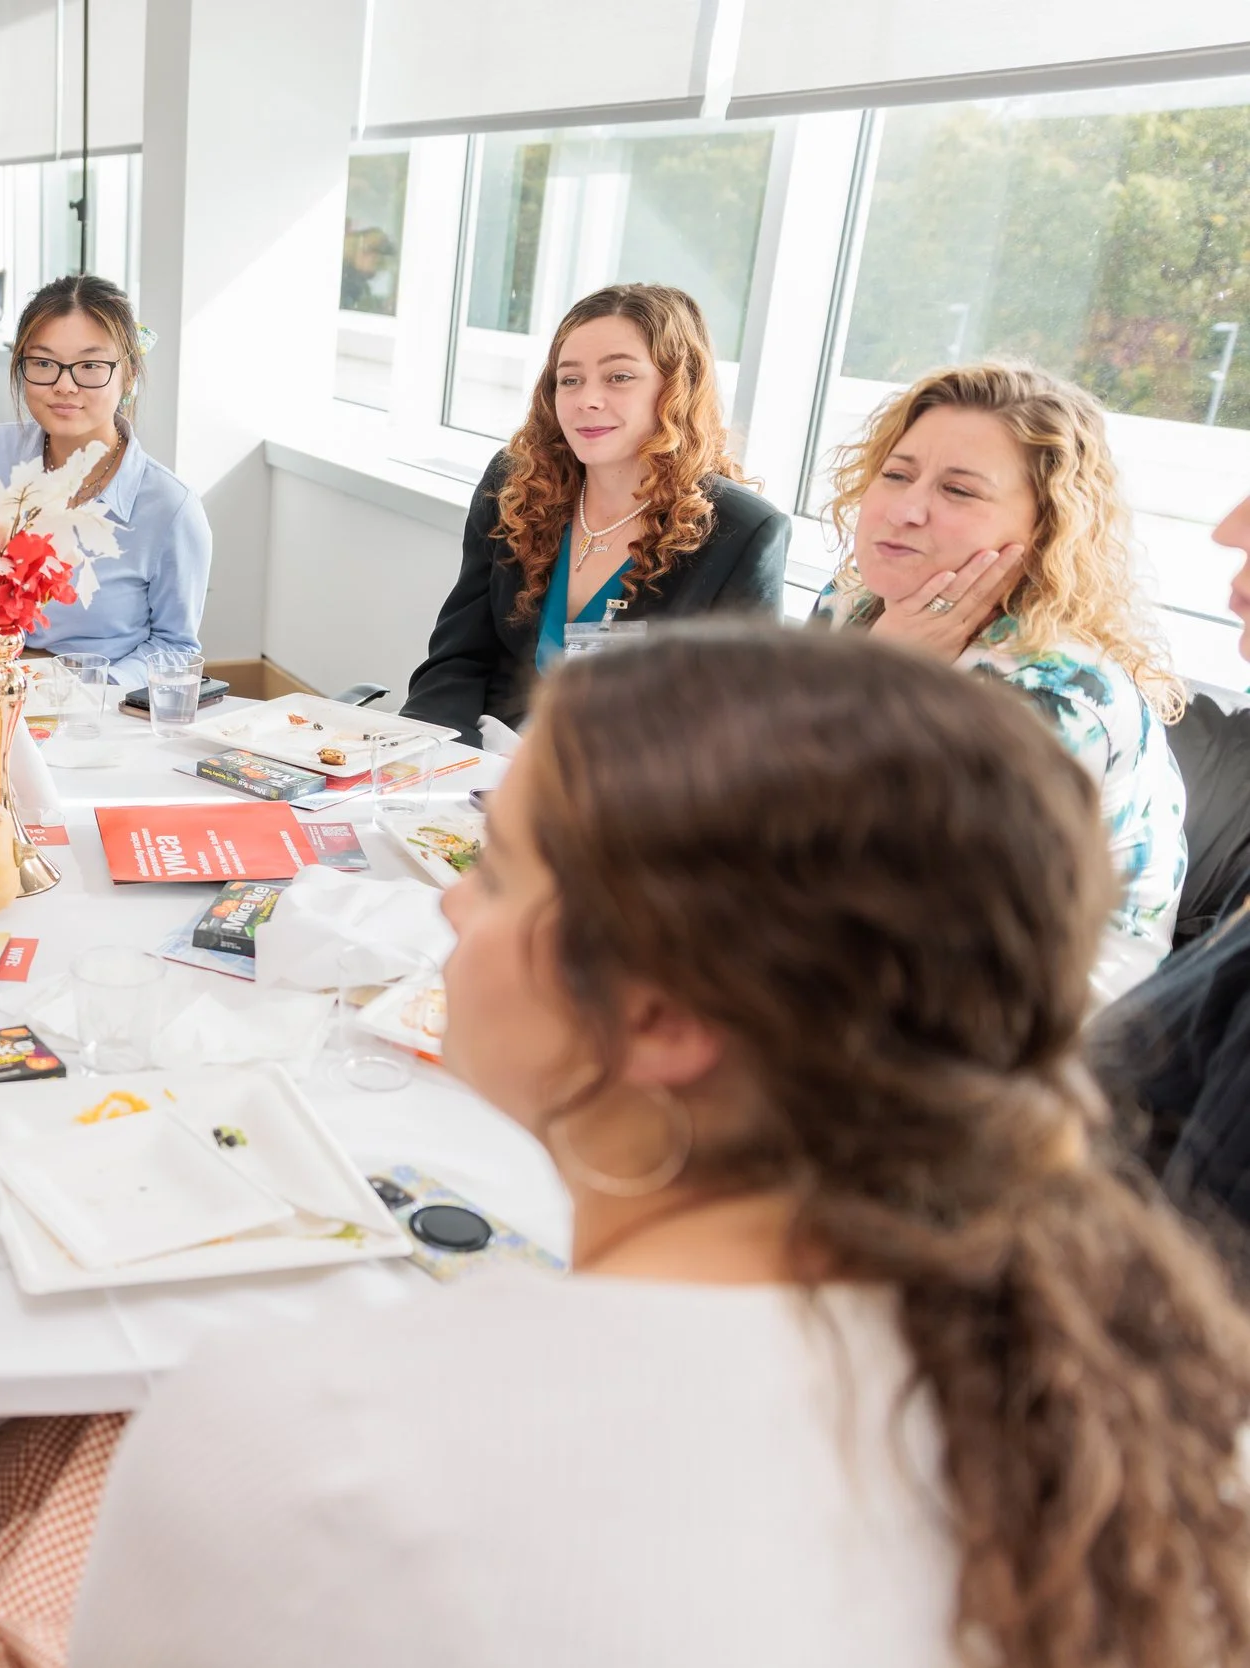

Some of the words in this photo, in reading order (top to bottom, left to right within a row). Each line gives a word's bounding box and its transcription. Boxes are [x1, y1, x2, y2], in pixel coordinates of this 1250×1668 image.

[250, 765, 298, 782] Mike
[156, 835, 198, 876] ywca
[221, 902, 256, 932] Mike
[243, 886, 270, 904] Ike
